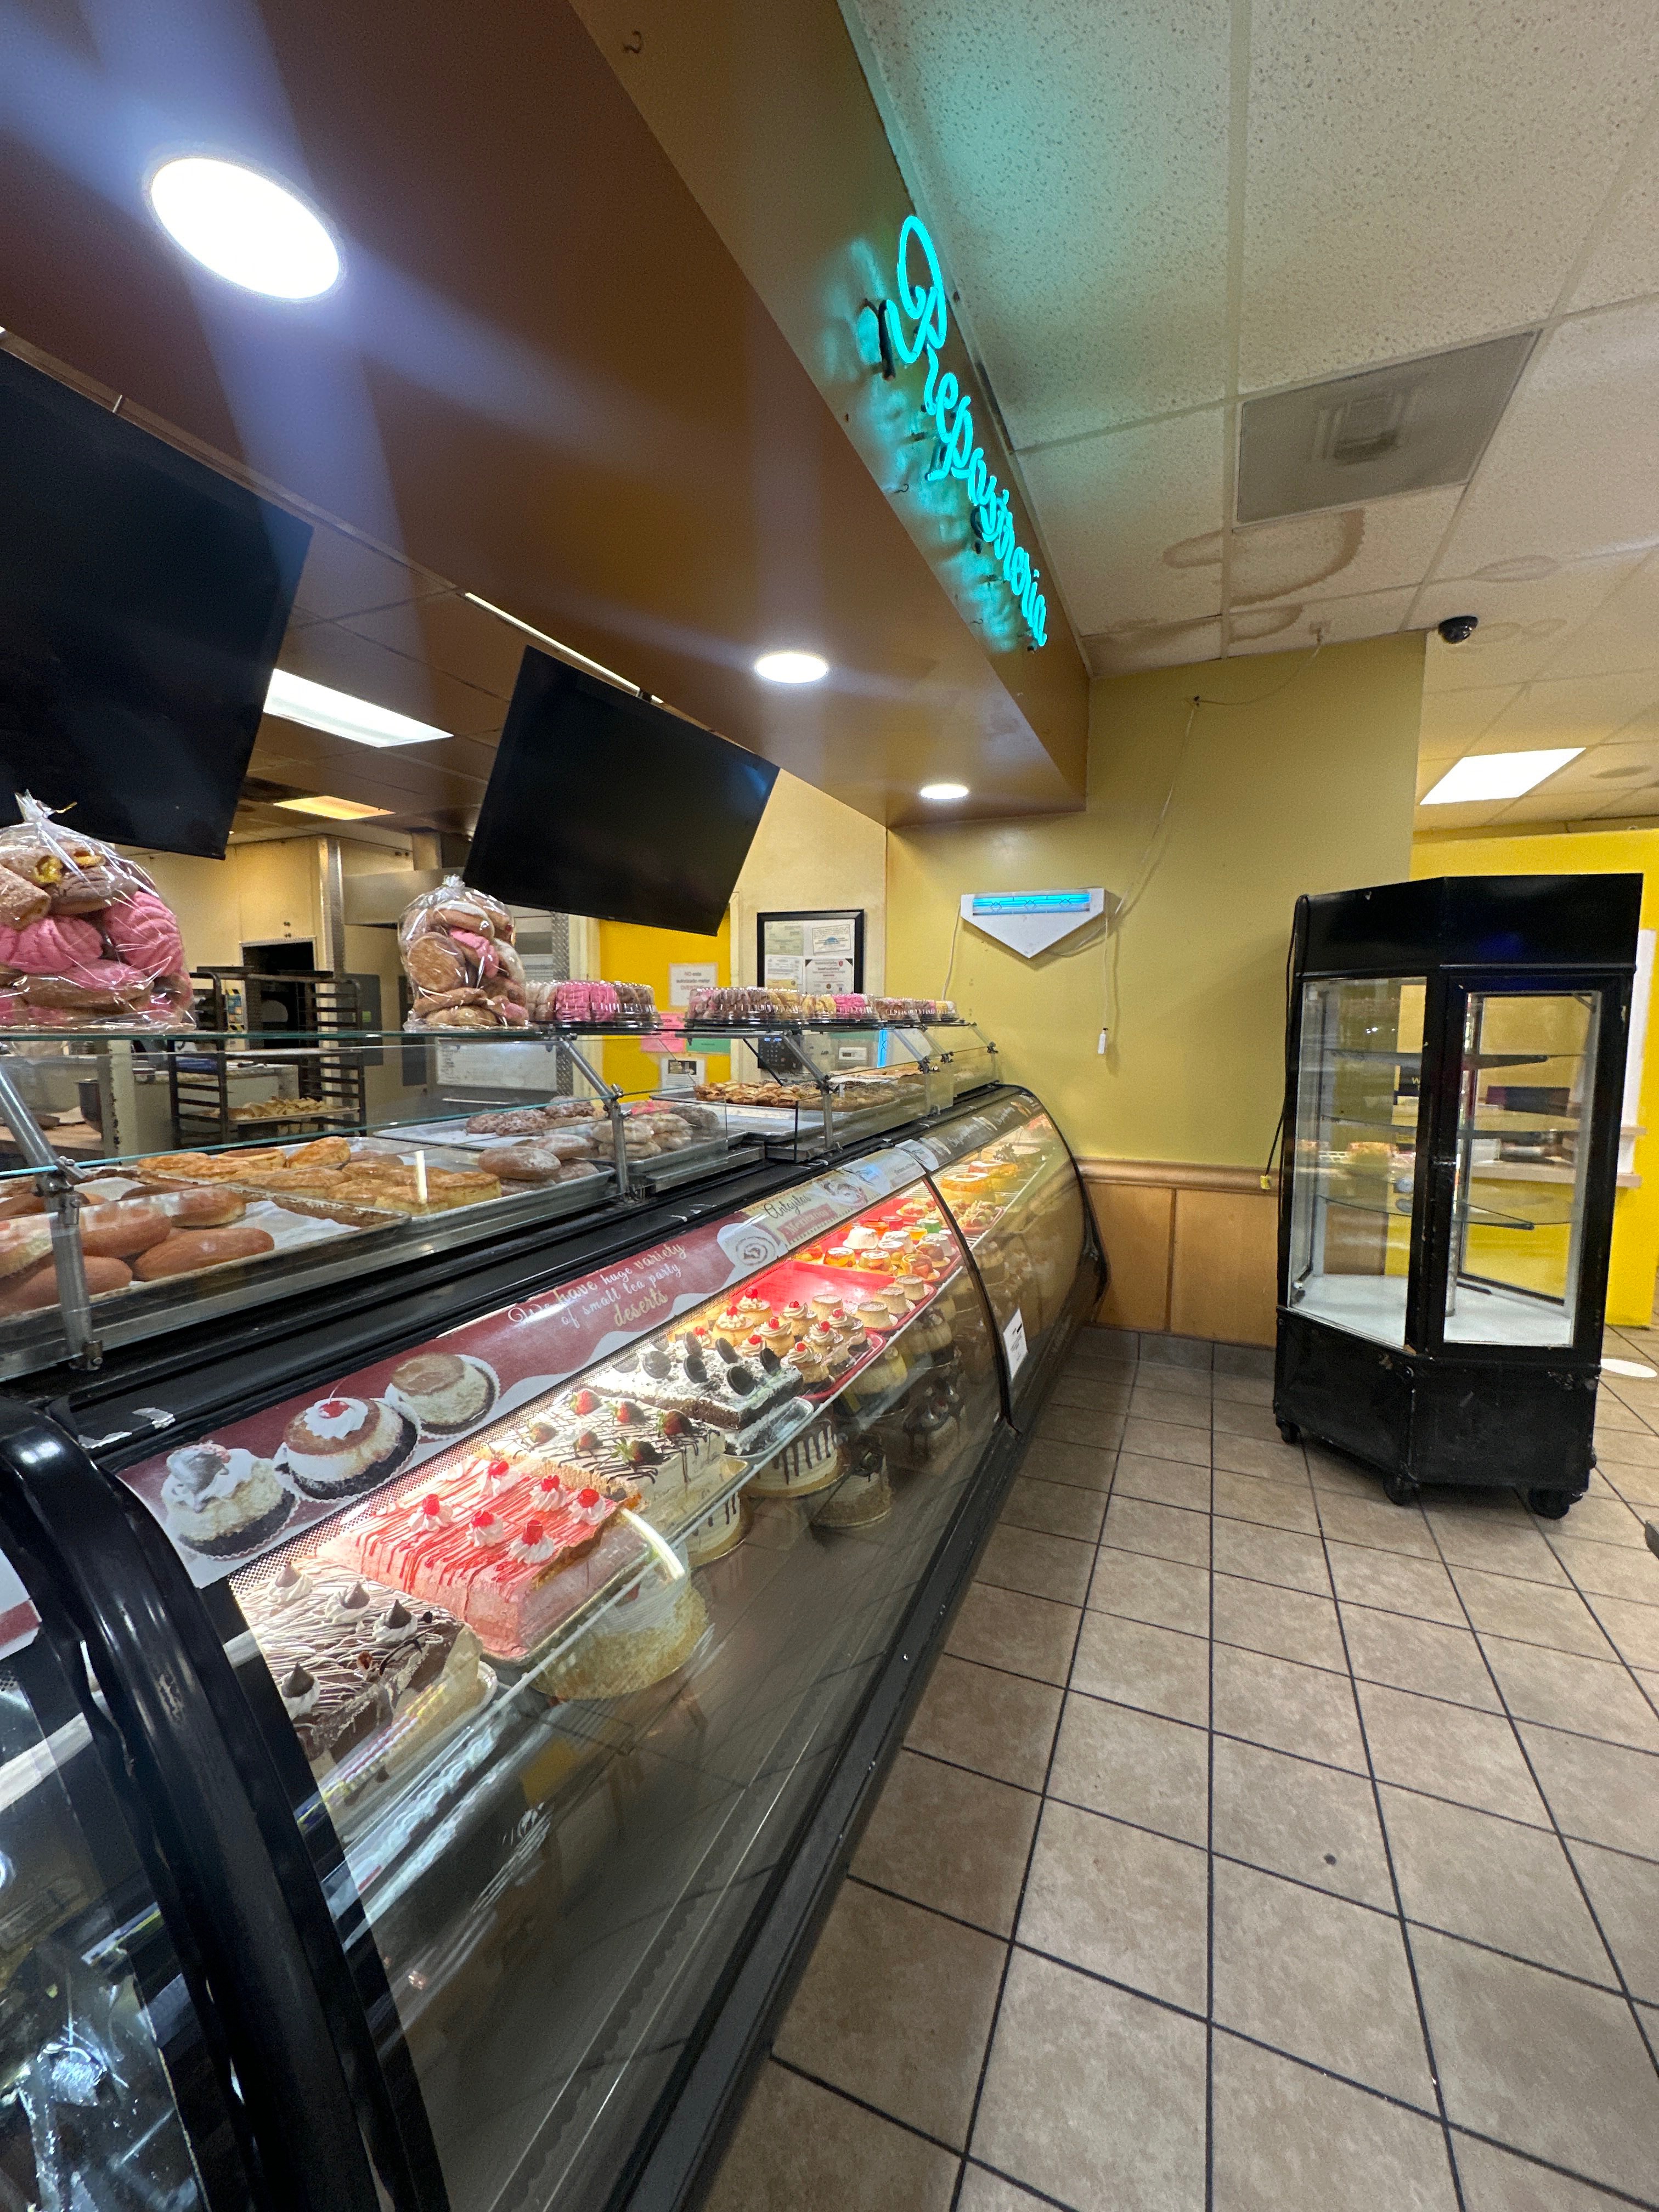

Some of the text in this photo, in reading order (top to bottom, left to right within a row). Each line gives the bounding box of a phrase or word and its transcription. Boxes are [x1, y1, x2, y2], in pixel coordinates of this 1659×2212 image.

[763, 1194, 811, 1218] Antojitos
[552, 1281, 597, 1304] have
[600, 1267, 633, 1285] huge
[634, 1244, 686, 1269] variety
[561, 1307, 580, 1329] of
[582, 1287, 621, 1315] small
[648, 1263, 681, 1288] party
[614, 1288, 668, 1327] deserts
